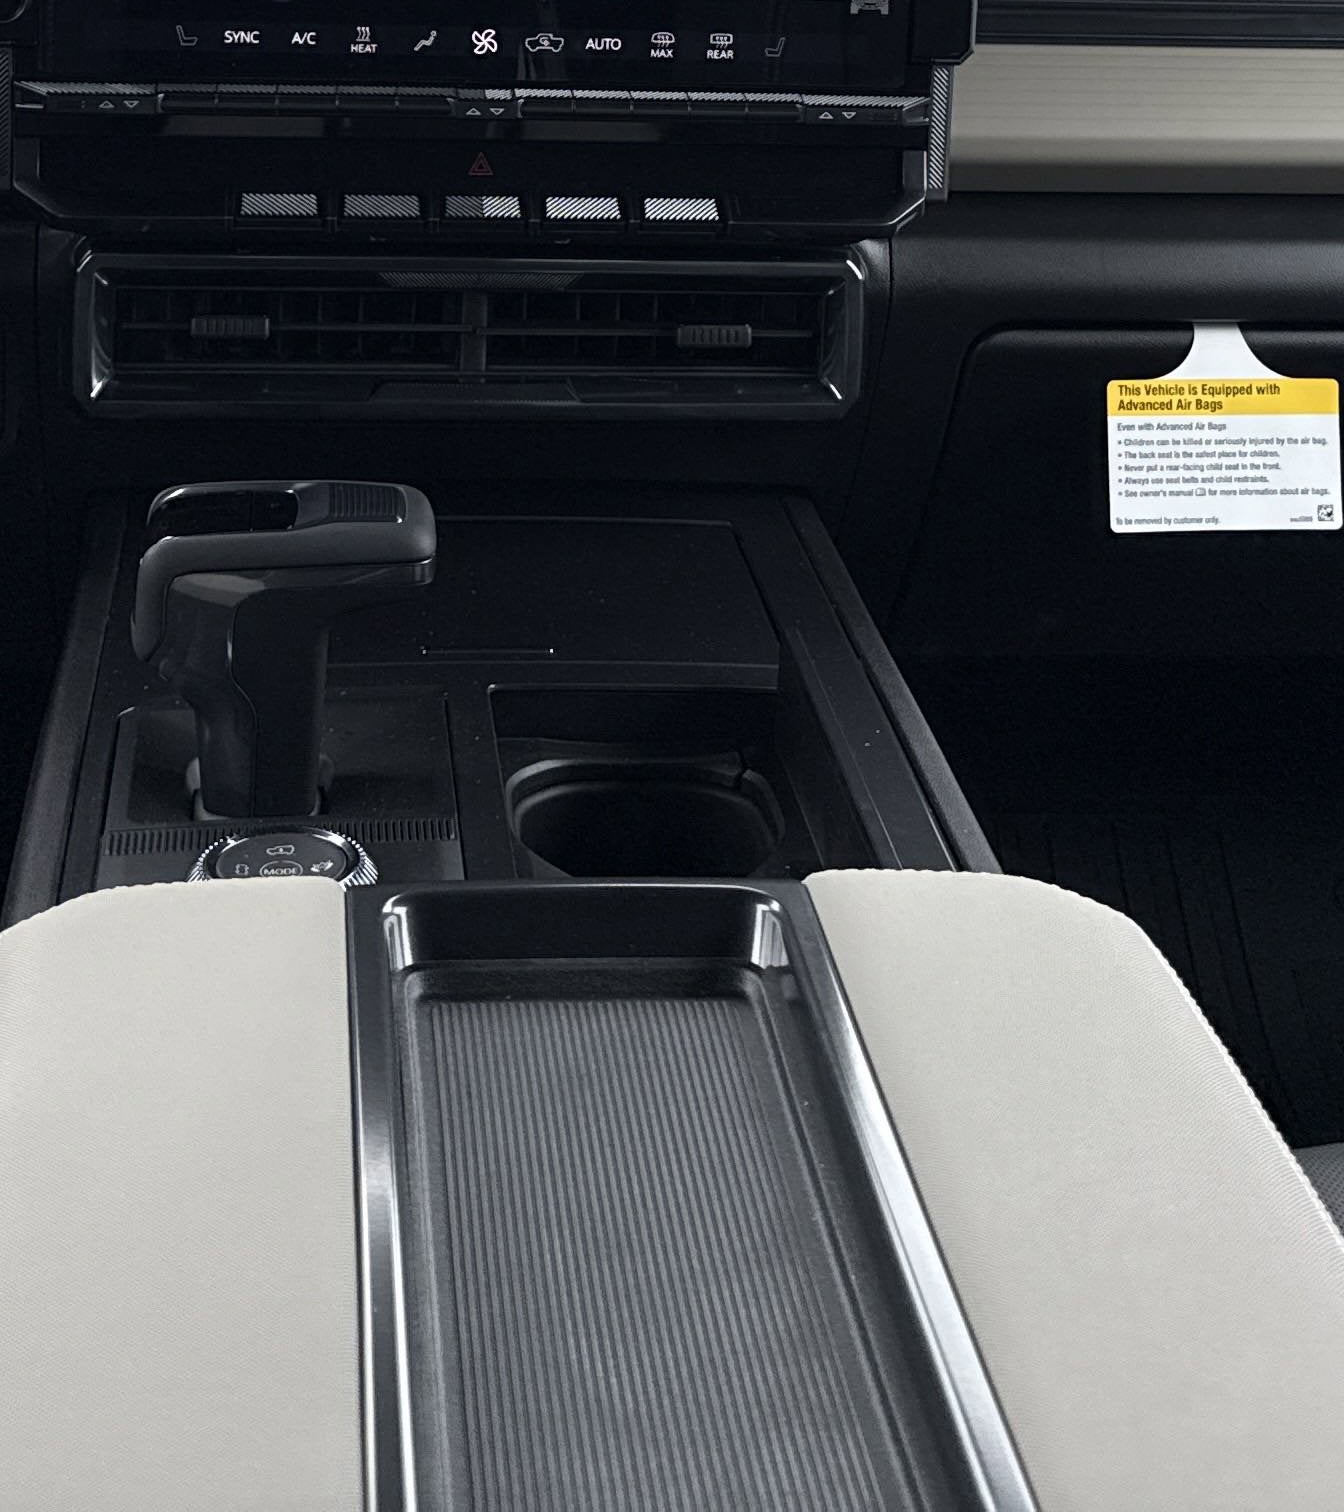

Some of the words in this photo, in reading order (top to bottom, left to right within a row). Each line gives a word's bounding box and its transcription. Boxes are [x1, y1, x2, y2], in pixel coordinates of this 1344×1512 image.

[223, 30, 260, 45] SYNC
[291, 31, 317, 45] A/C
[350, 43, 378, 54] HEAT
[585, 37, 622, 51] AUTO
[650, 48, 674, 59] MAX
[706, 49, 735, 60] REAR
[1118, 384, 1141, 396] This
[1144, 384, 1185, 396] Vehicle
[1201, 383, 1252, 398] Equipped
[1256, 383, 1280, 395] with
[1118, 399, 1172, 411] Advanced
[1176, 399, 1192, 411] Air
[1195, 398, 1223, 412] Bags
[1117, 423, 1135, 431] Even
[1138, 423, 1154, 431] with
[1195, 422, 1205, 430] Air
[1208, 422, 1226, 431] Bags
[1214, 438, 1246, 446] seriously
[1249, 437, 1274, 446] injured
[1276, 437, 1285, 446] by
[1218, 450, 1236, 459] place
[1146, 464, 1157, 472] put
[1166, 463, 1204, 472] rear-facing
[1125, 477, 1149, 485] Always
[1125, 489, 1137, 497] See
[1116, 517, 1123, 525] To
[1125, 517, 1132, 525] be
[1134, 516, 1162, 524] removed
[1164, 517, 1172, 526] by
[1173, 516, 1203, 524] customer
[264, 867, 297, 875] MODE
